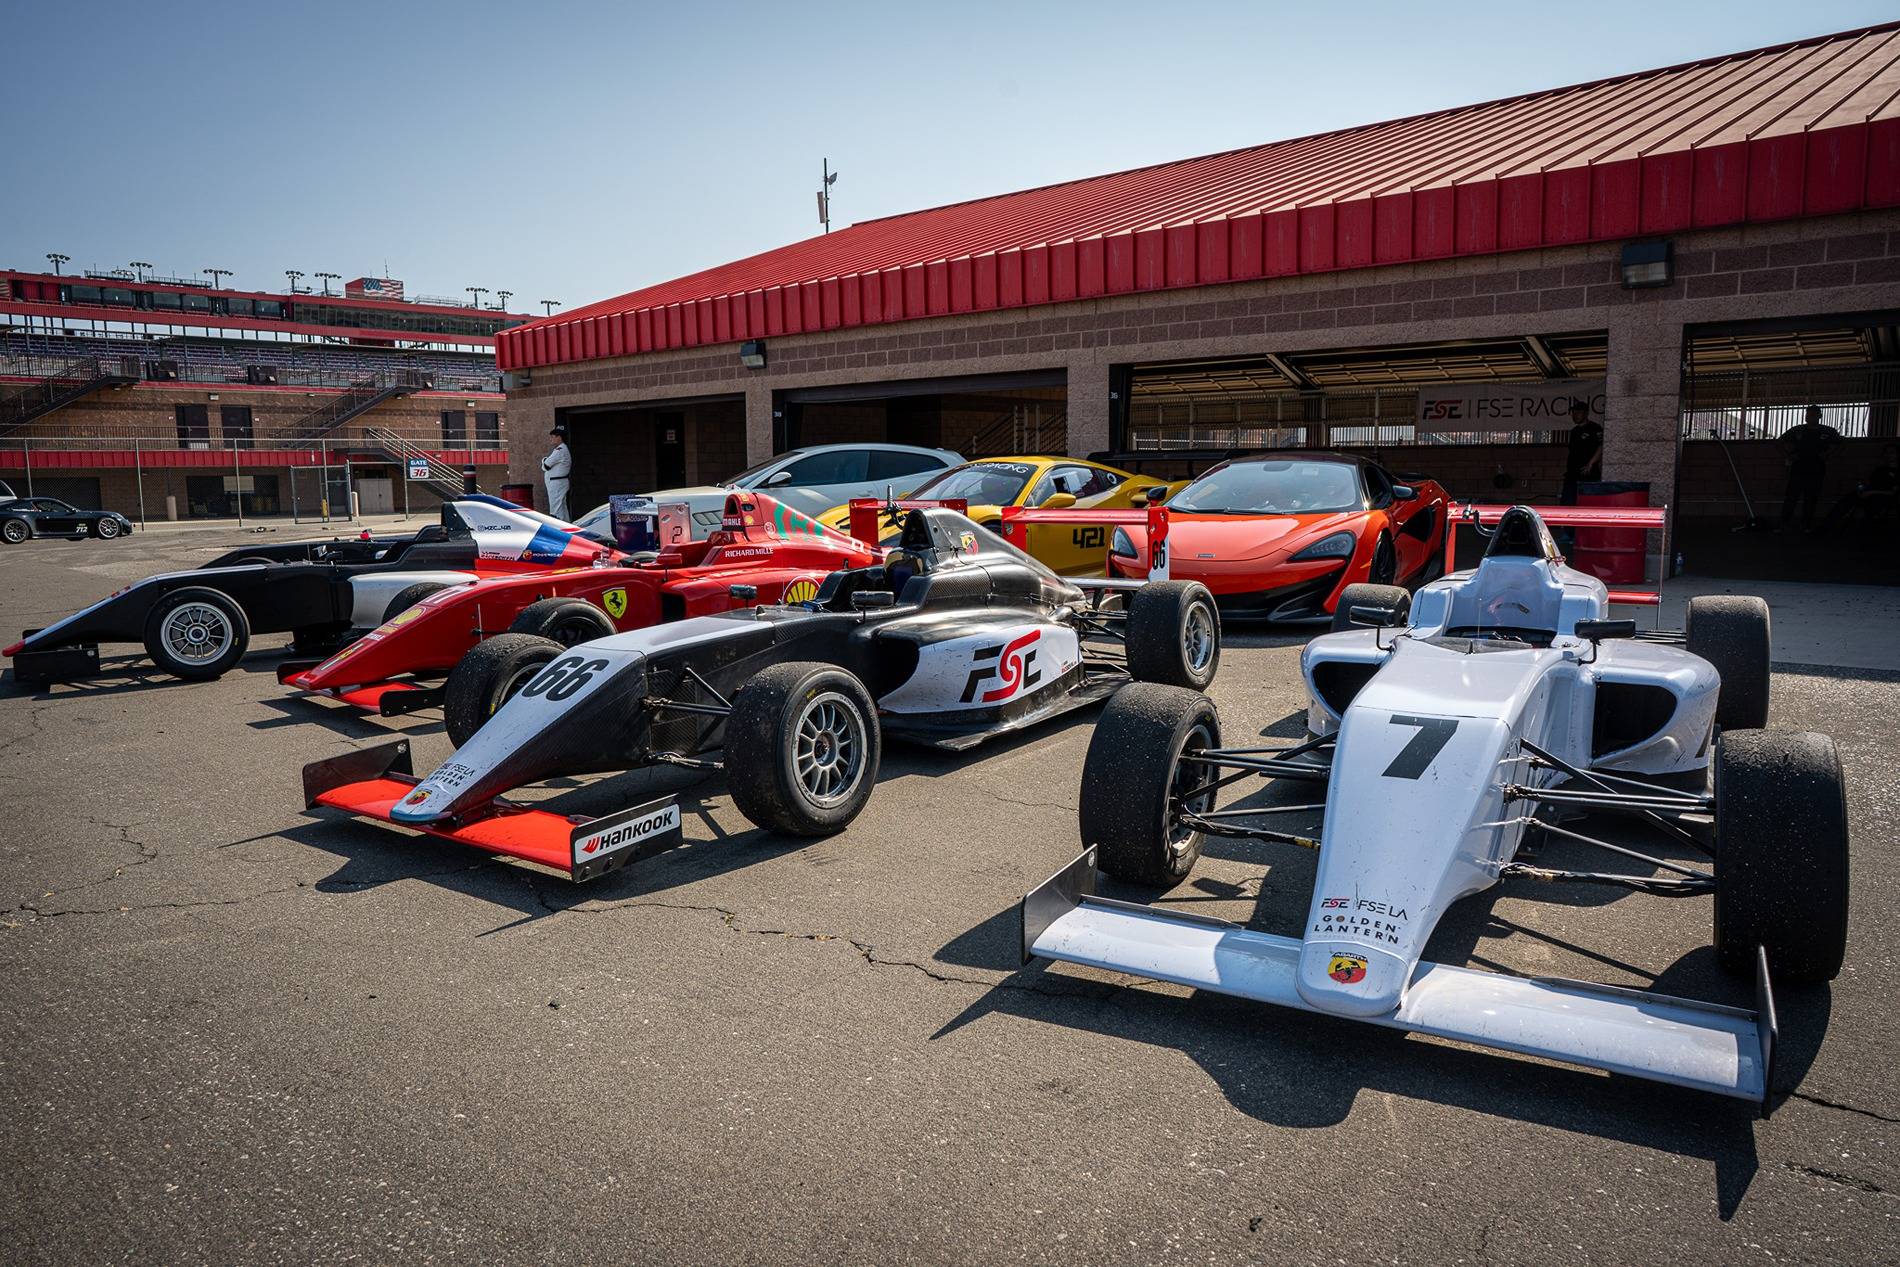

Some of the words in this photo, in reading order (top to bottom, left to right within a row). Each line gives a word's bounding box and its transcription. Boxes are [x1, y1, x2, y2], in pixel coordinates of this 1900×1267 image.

[1477, 398, 1514, 418] FSE
[1520, 395, 1606, 417] RACING
[412, 469, 427, 477] 36
[722, 517, 741, 526] MAHLE
[1072, 526, 1105, 549] 421
[724, 548, 755, 558] RICHARD
[755, 547, 774, 557] MILLE
[1152, 540, 1166, 570] 66
[521, 656, 610, 702] 66
[1381, 714, 1460, 781] 7
[1358, 900, 1387, 914] FSE
[1388, 905, 1408, 921] LA
[1322, 914, 1396, 933] GOLDEN
[1314, 924, 1399, 945] LANTERN
